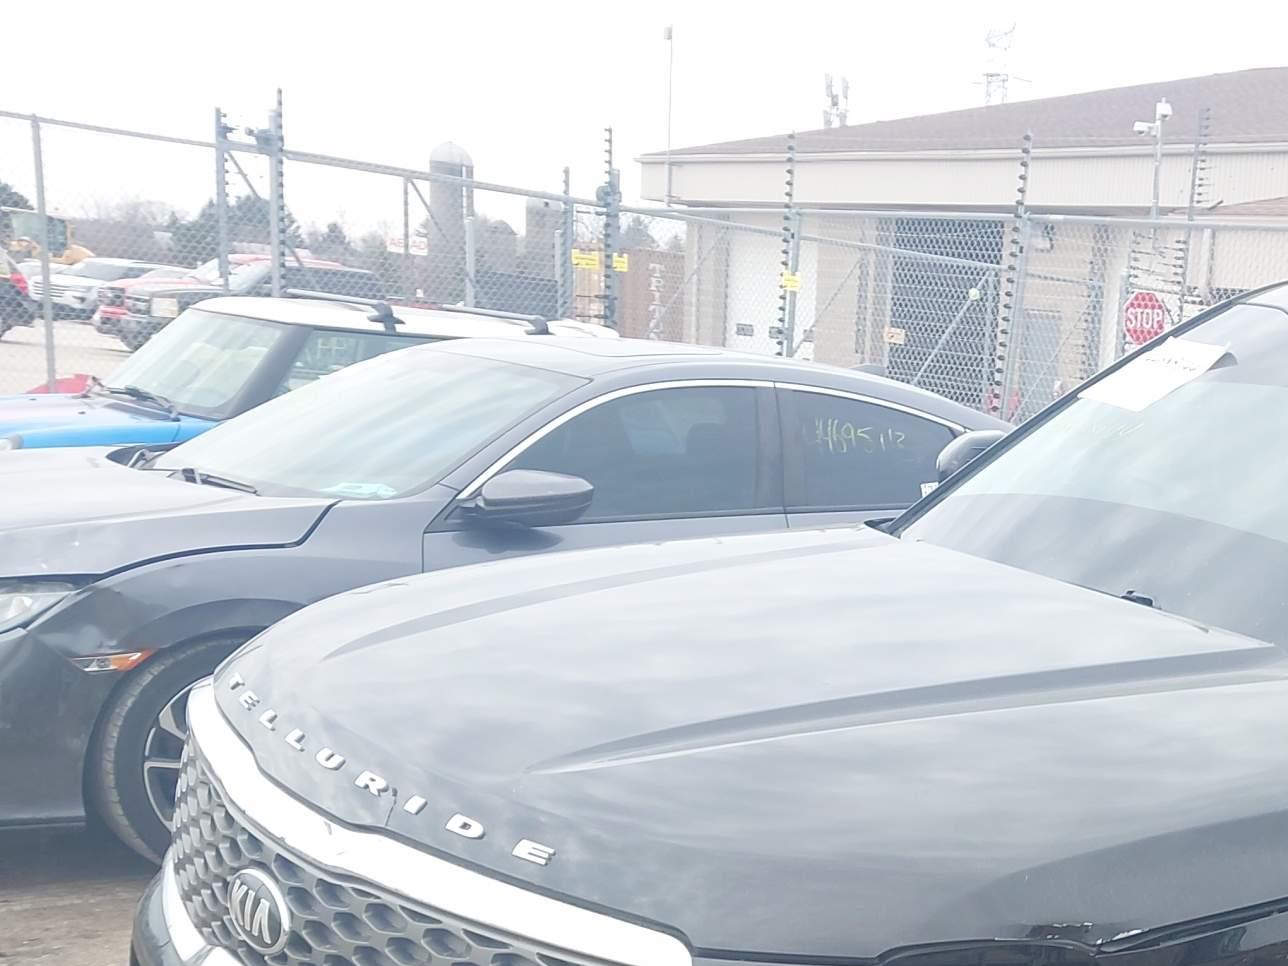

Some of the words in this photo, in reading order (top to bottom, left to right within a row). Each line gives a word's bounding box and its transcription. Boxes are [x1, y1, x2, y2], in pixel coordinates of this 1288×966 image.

[1126, 307, 1163, 330] STOP
[229, 671, 556, 866] TELLURIDE
[232, 879, 270, 943] KIA
